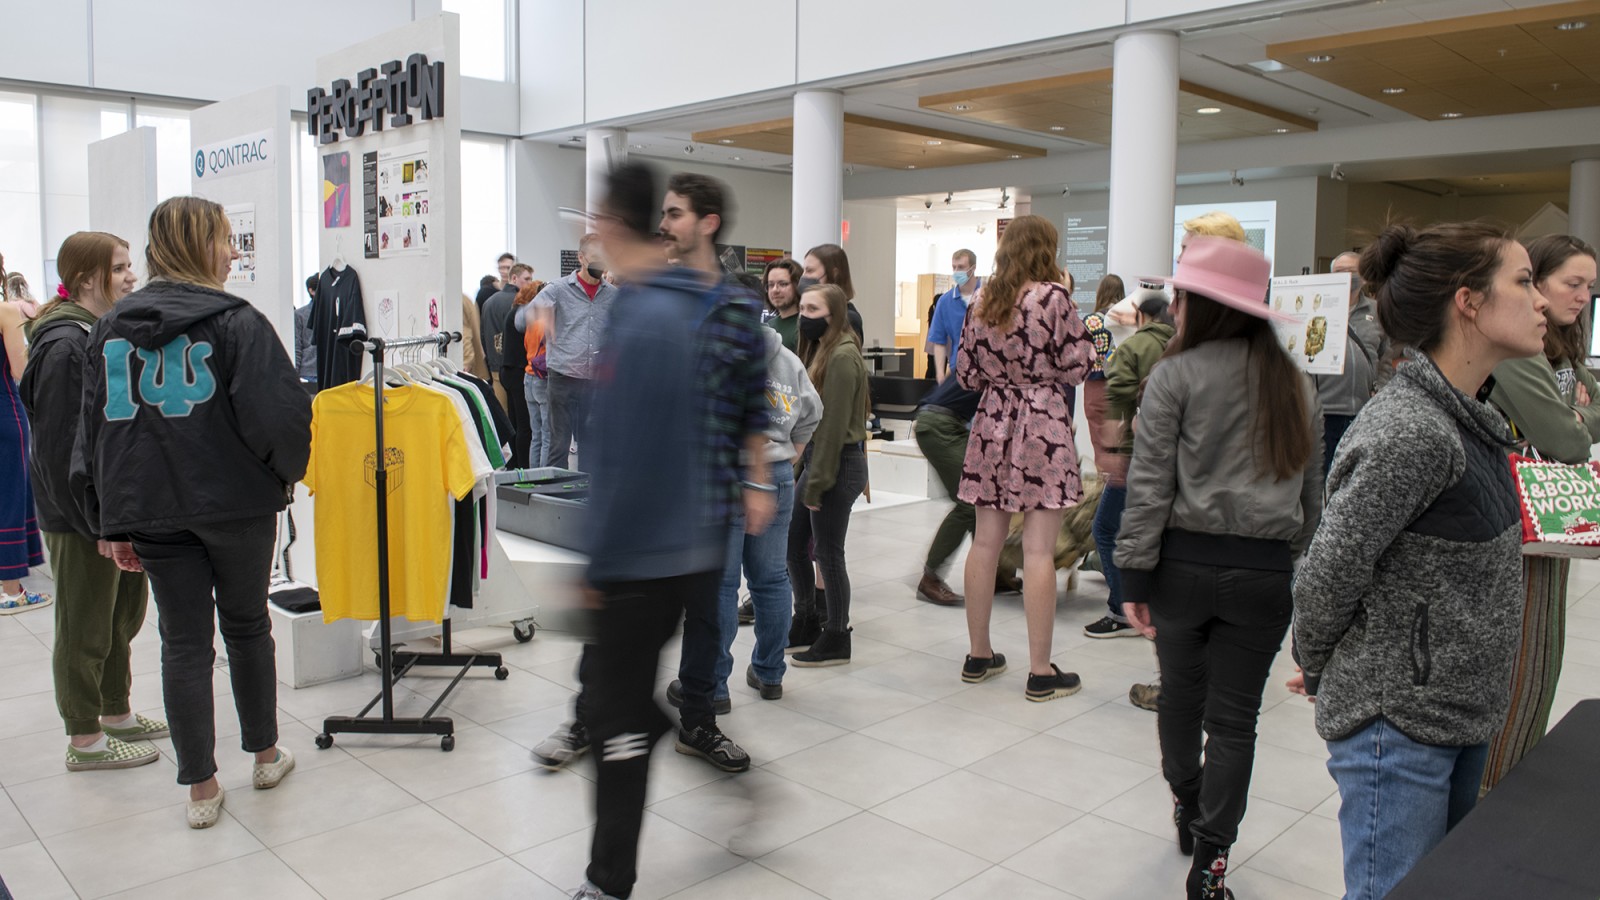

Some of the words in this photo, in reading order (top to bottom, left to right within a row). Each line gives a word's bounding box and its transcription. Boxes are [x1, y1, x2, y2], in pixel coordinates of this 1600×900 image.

[307, 53, 444, 144] PERCEPTION
[209, 138, 268, 173] QONTRAC
[1531, 467, 1582, 482] BATH
